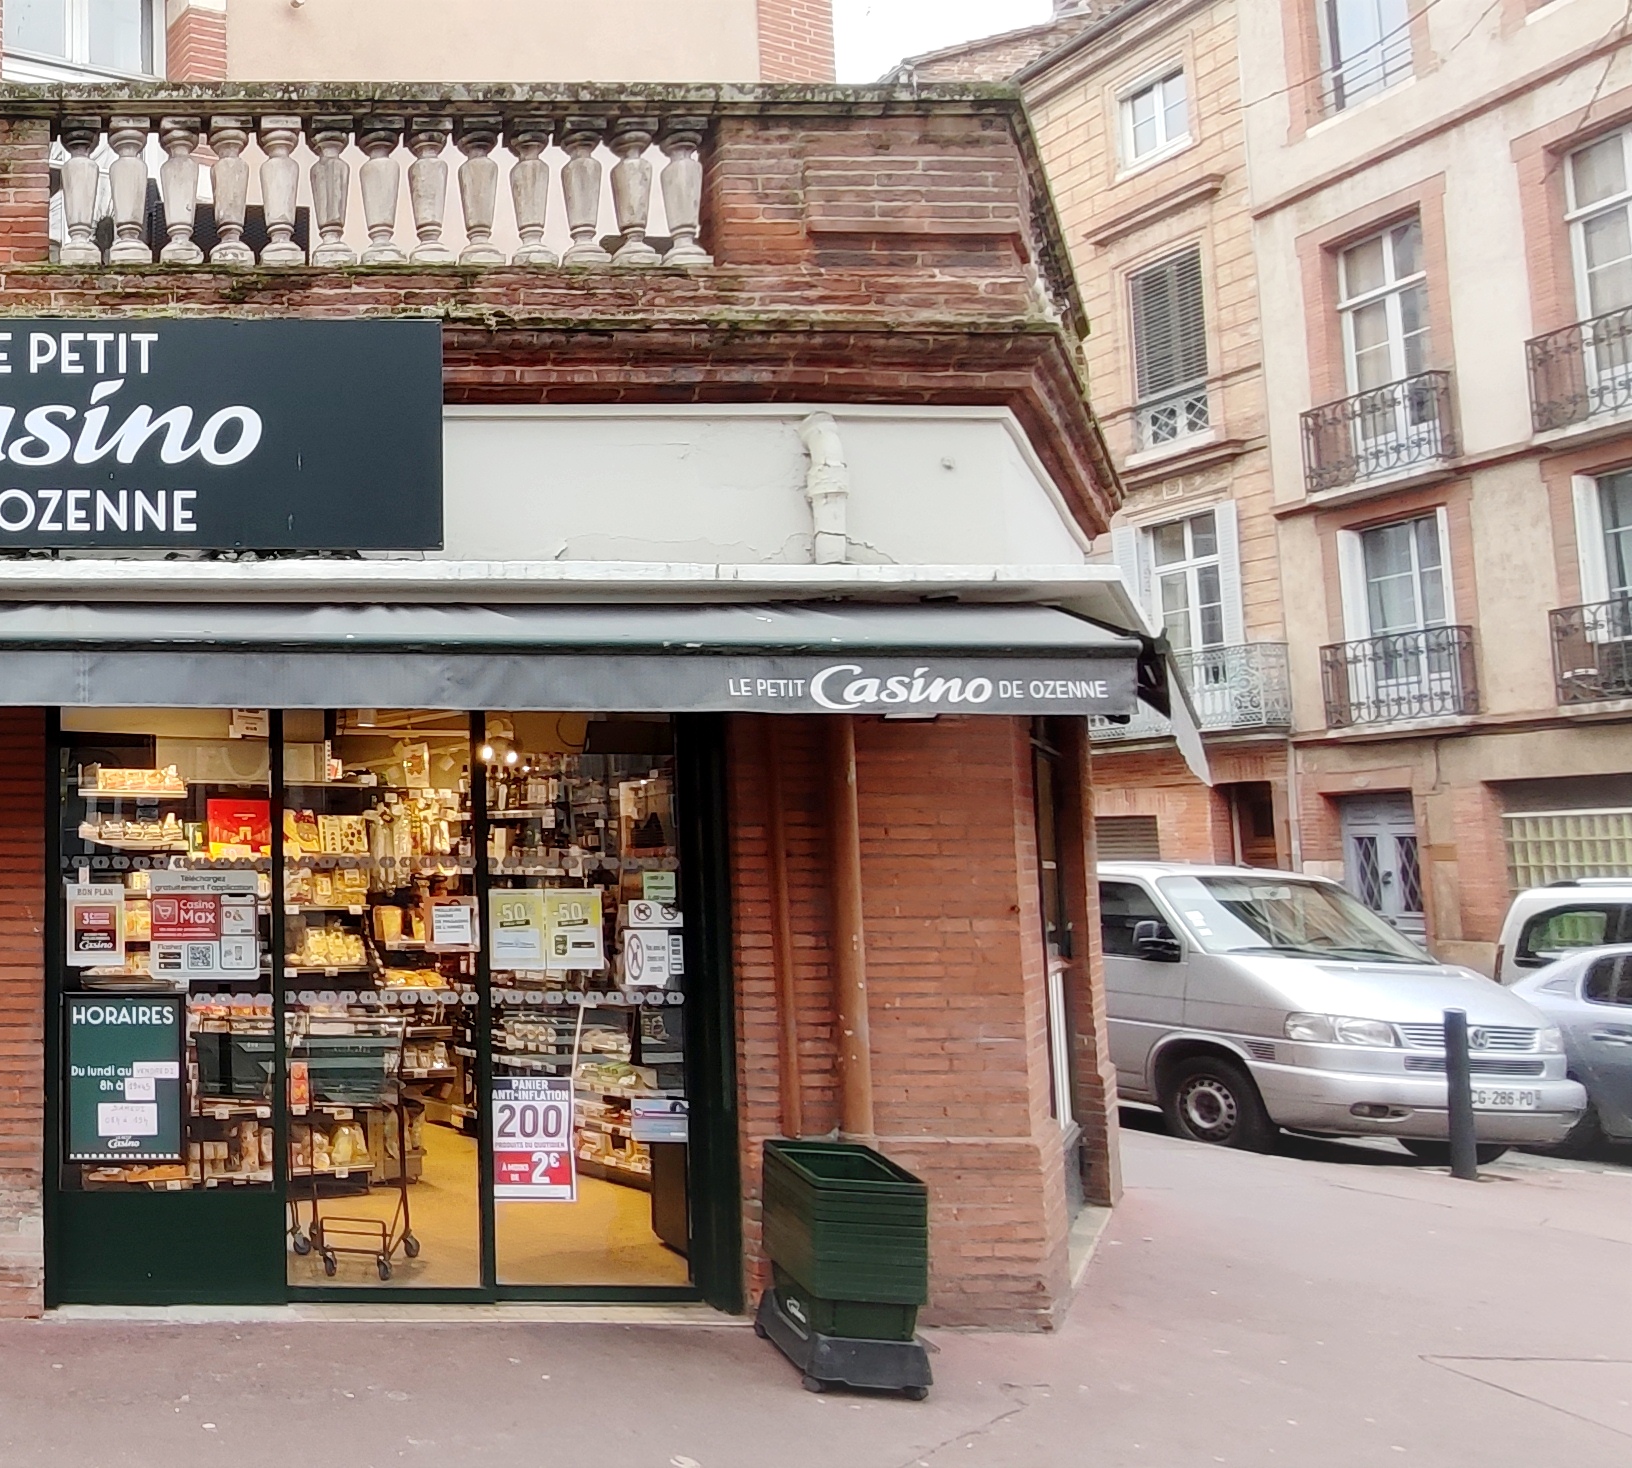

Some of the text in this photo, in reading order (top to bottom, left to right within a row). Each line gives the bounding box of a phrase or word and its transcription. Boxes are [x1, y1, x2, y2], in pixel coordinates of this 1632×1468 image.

[30, 333, 158, 373] PETIT
[729, 665, 1108, 709] LE PETIT Casino DE OZENNE
[77, 888, 113, 896] BON PLAN
[180, 900, 215, 909] Casino
[180, 910, 215, 924] Max
[79, 940, 113, 950] Casino
[72, 1006, 174, 1025] HORAIRES
[71, 1065, 132, 1076] Du lundi au
[136, 1067, 174, 1075] VENDREDI
[100, 1080, 124, 1090] 8h à
[512, 1080, 549, 1089] PANIER
[492, 1090, 568, 1100] ANTI-INFLATION
[498, 1104, 562, 1138] 200
[108, 1138, 140, 1148] Casino
